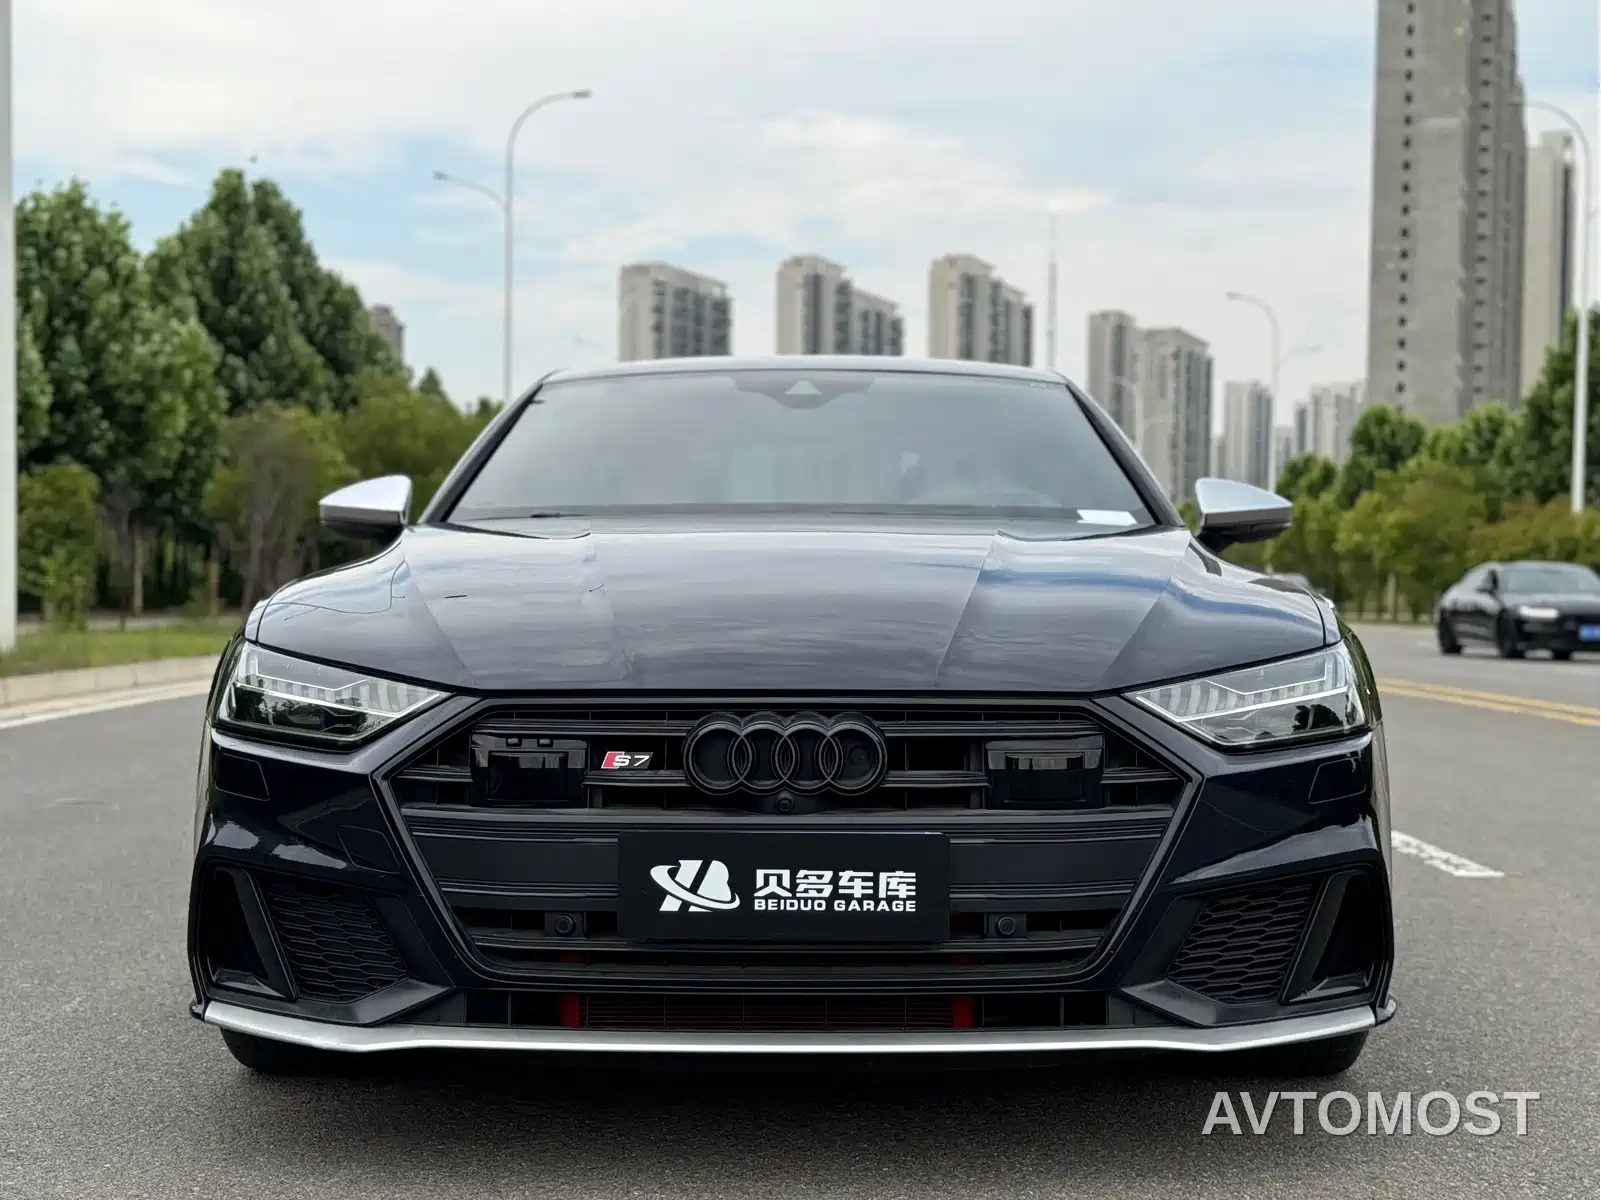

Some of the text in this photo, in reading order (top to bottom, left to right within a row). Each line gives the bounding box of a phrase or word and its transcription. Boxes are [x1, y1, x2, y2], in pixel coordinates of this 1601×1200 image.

[612, 754, 650, 767] S7
[753, 868, 917, 899] 贝多车库
[754, 899, 917, 912] BEIDUO GARAGE
